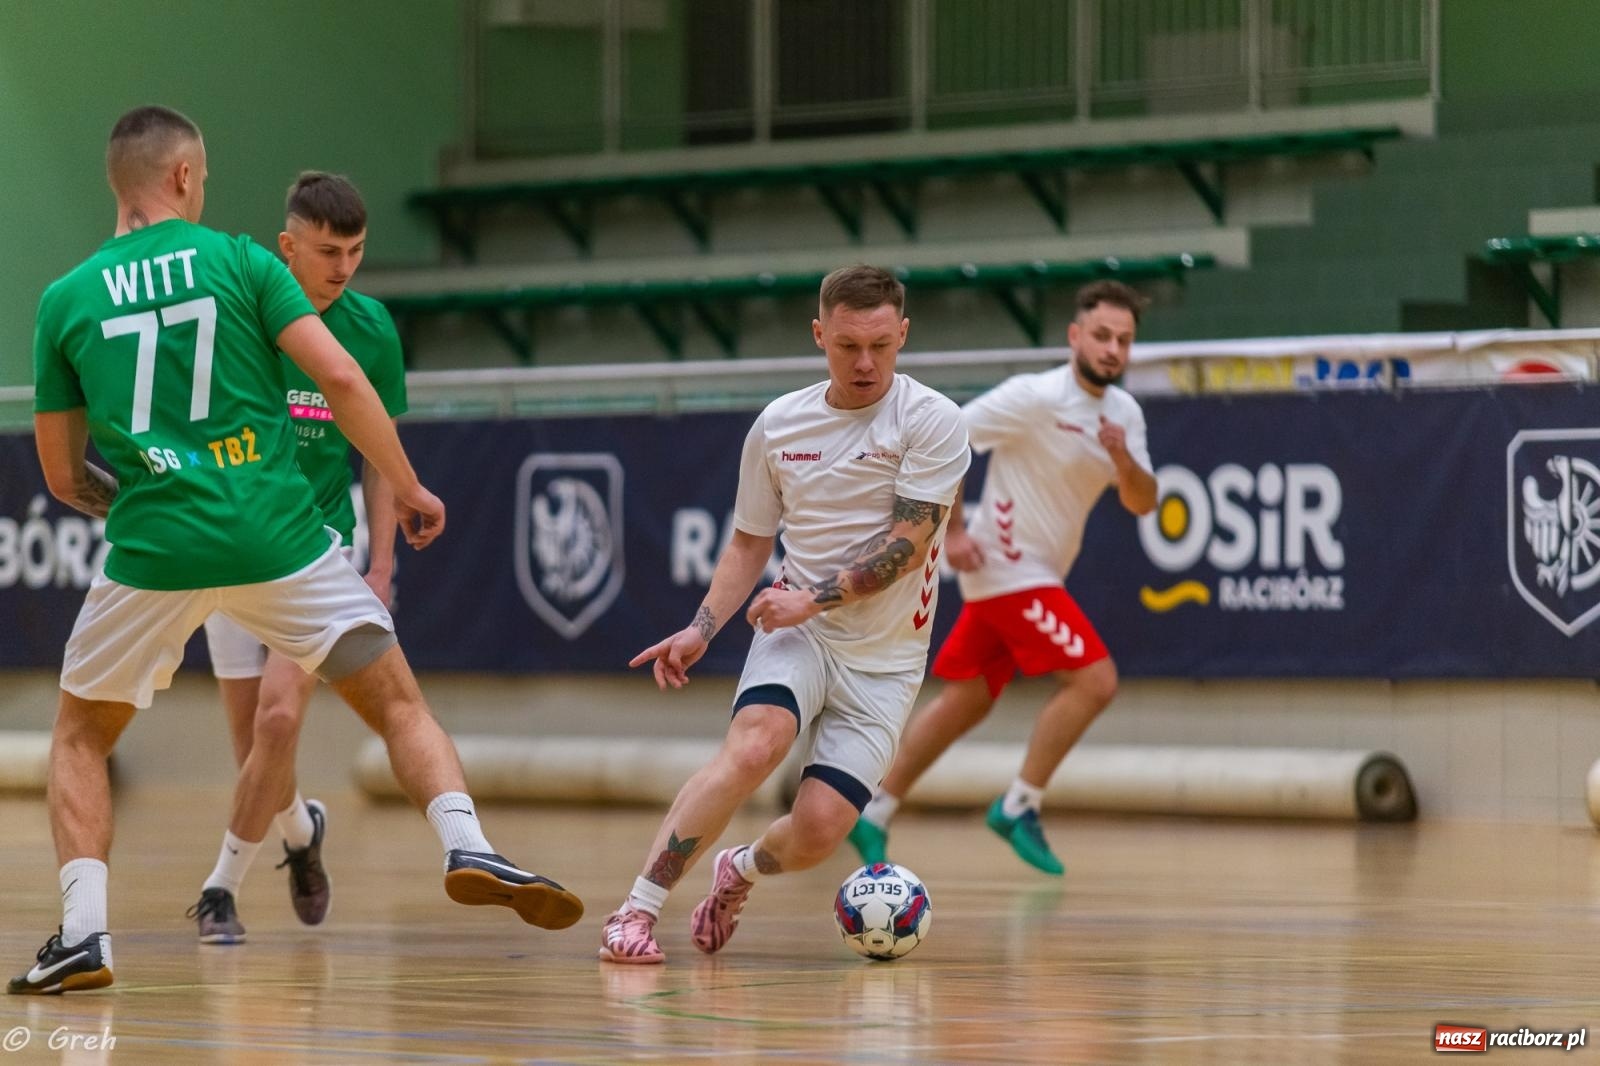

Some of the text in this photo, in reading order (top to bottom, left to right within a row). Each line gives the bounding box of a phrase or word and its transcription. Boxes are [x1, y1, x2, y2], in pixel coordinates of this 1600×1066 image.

[102, 248, 198, 306] WITT
[101, 296, 217, 434] 77
[208, 427, 262, 468] TBŻ
[782, 451, 821, 461] hummel
[1138, 463, 1345, 572] OSiR
[1219, 567, 1345, 611] RACIBÓRZ
[853, 882, 902, 898] SELECT
